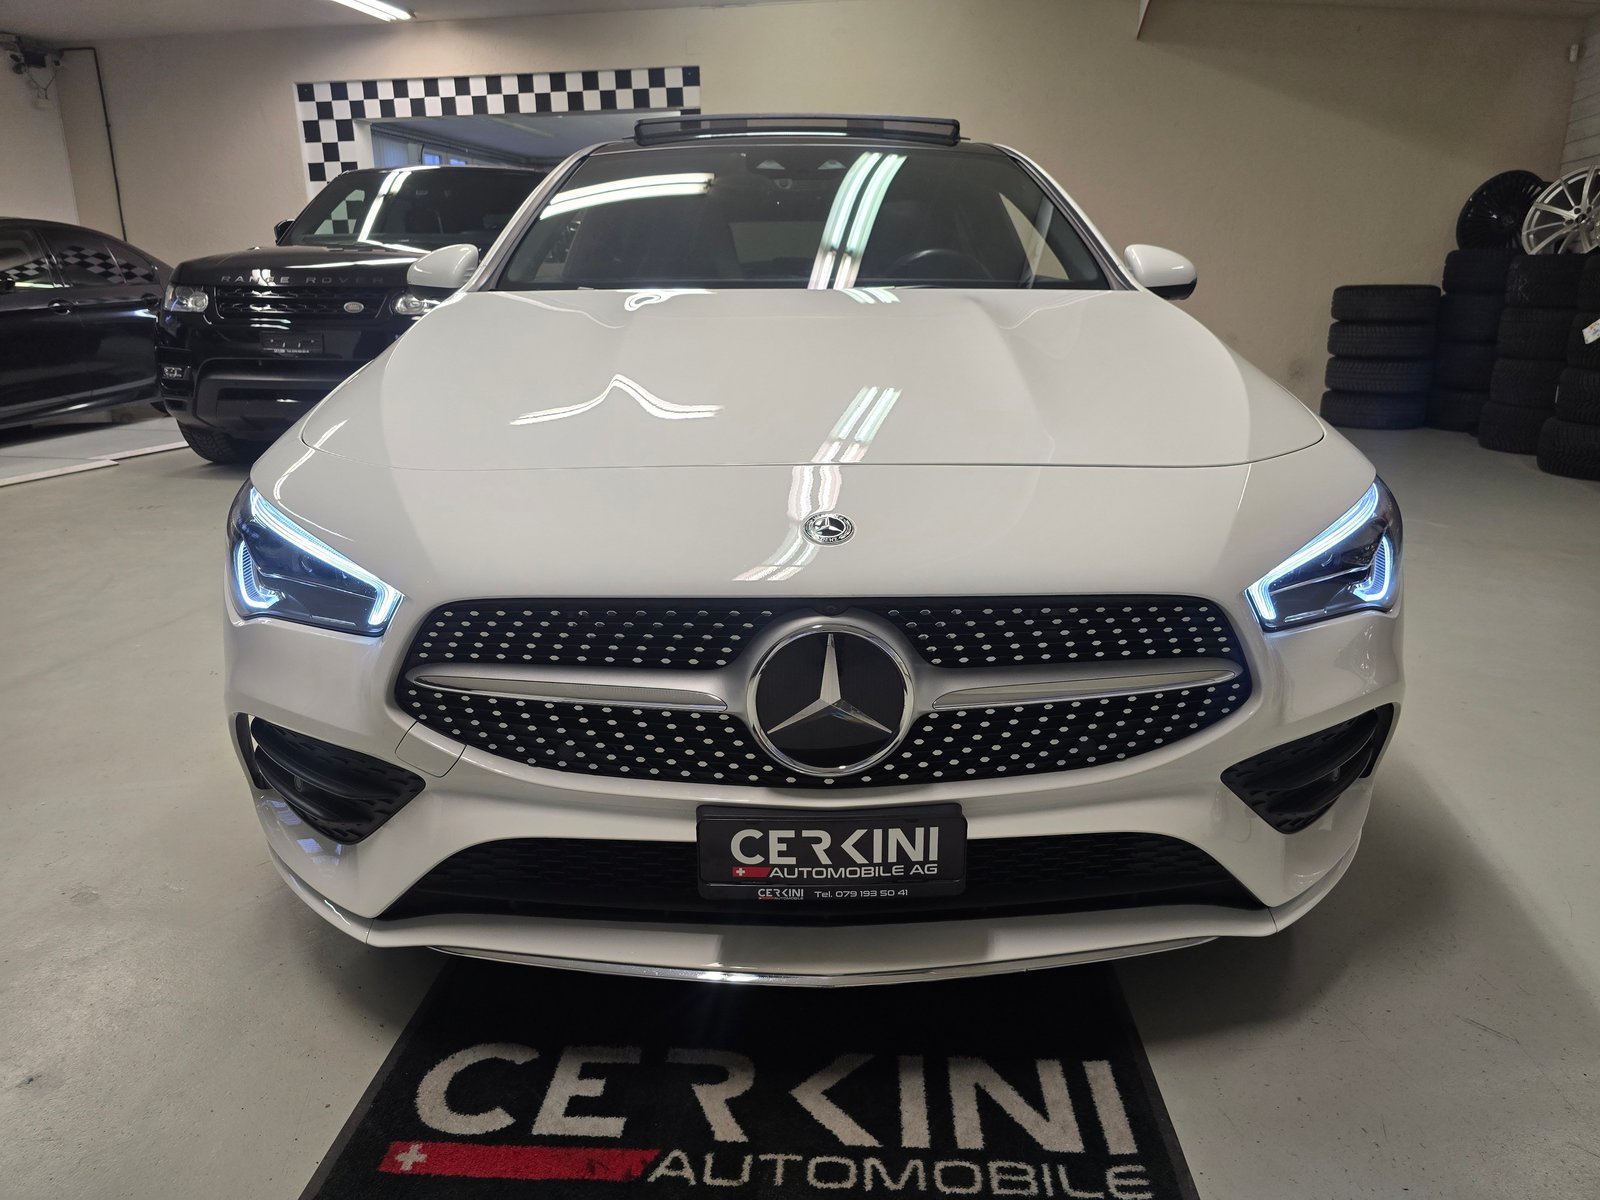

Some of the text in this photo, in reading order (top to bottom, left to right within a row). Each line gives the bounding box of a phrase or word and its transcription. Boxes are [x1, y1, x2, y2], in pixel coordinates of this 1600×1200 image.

[305, 276, 384, 284] ROVER
[731, 827, 939, 865] CERKINI
[769, 864, 938, 879] AUTOMOBILE AG
[757, 888, 804, 897] CERKINI
[814, 890, 833, 898] Tel.
[835, 890, 858, 898] 079
[880, 889, 896, 897] 50
[897, 888, 908, 896] 41
[415, 1042, 1138, 1155] CERKINI
[647, 1149, 1153, 1200] AUTOMOBILE
